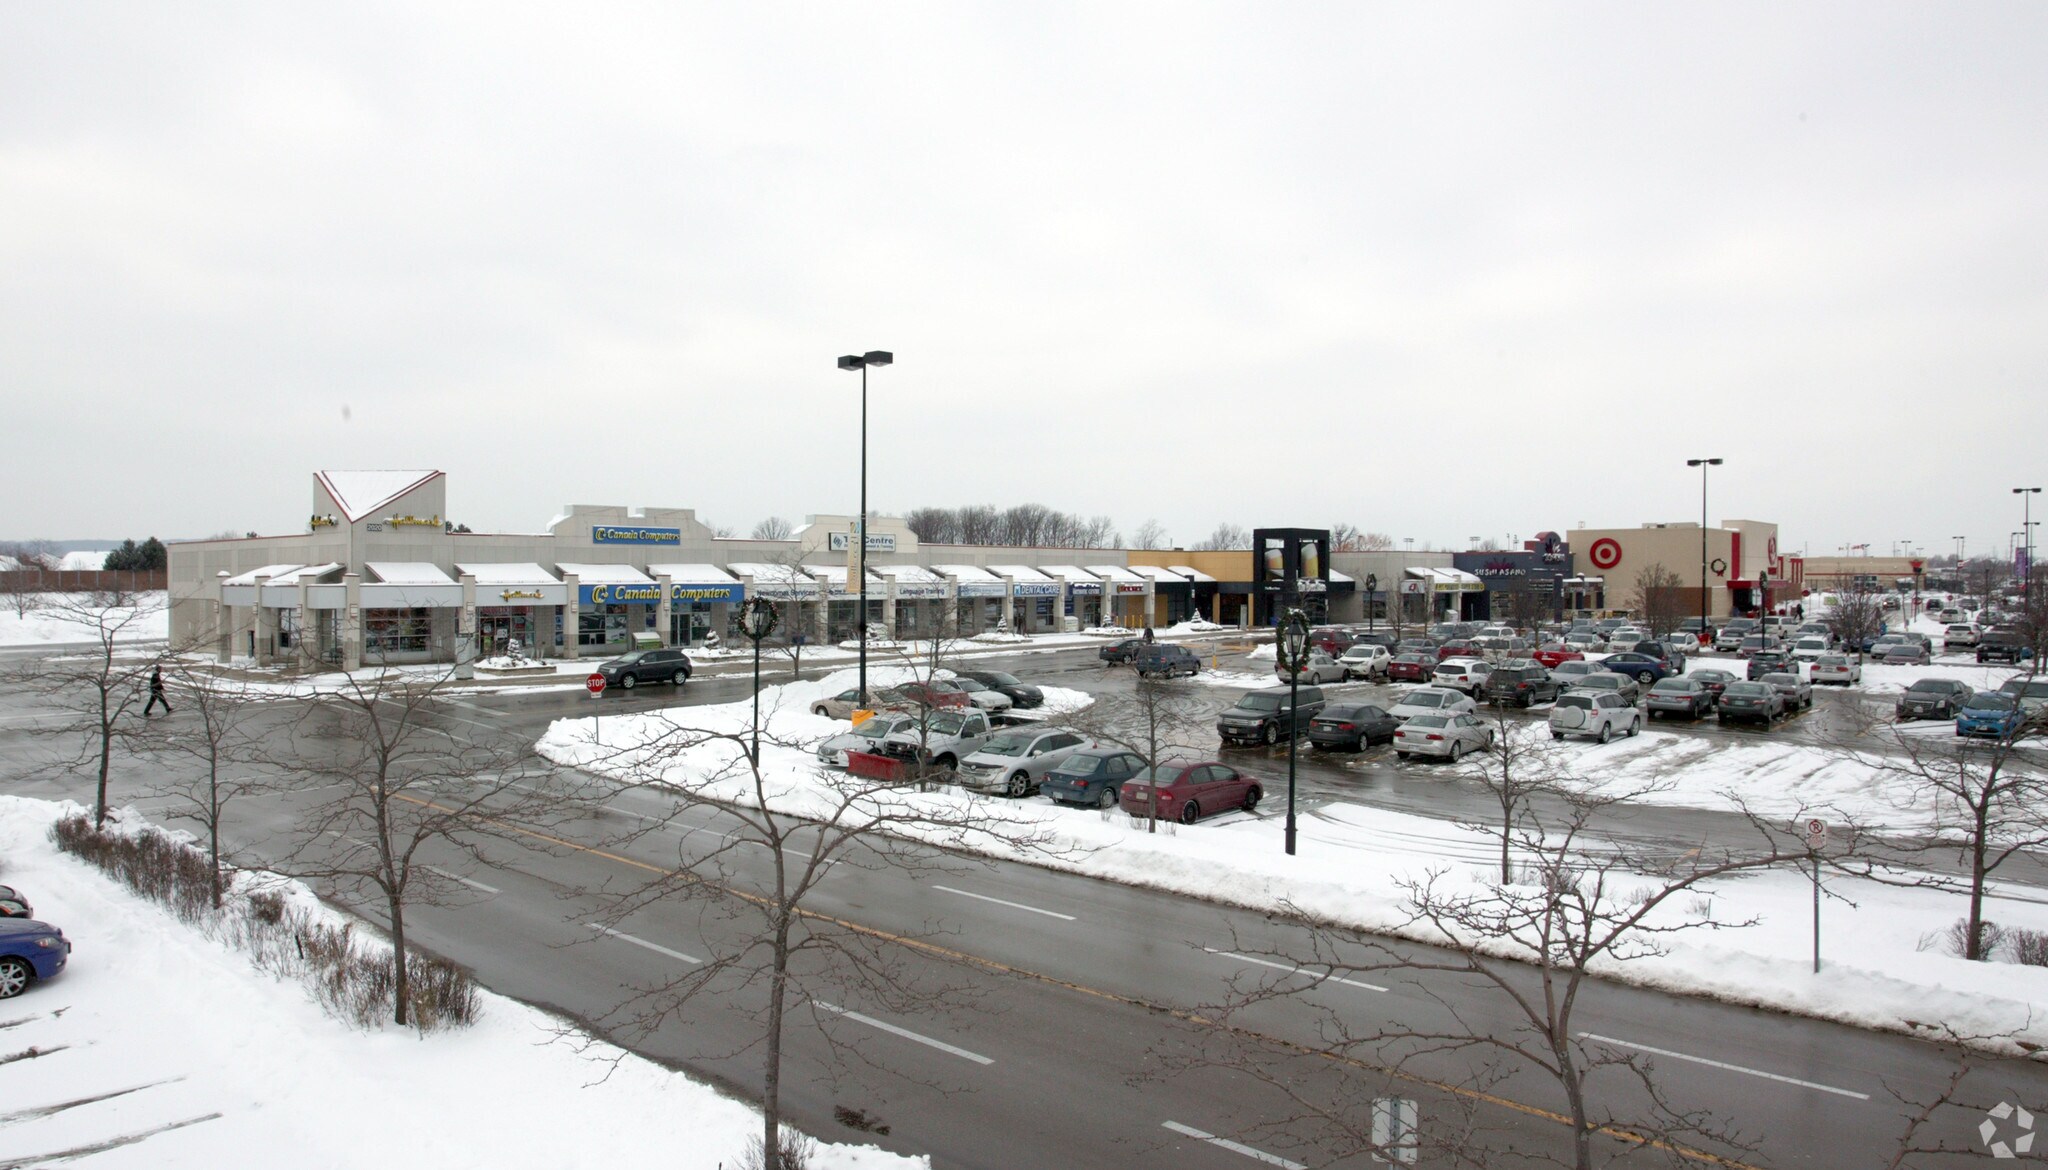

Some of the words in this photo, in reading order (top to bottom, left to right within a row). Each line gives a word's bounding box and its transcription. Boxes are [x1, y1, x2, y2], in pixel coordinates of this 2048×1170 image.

[367, 523, 382, 531] 2020
[607, 529, 638, 540] Canada
[639, 530, 680, 542] Computers
[615, 585, 661, 600] Canada
[671, 585, 730, 602] Computers
[1021, 585, 1044, 594] DENTAL
[1044, 585, 1060, 594] CARE
[587, 678, 605, 688] STOP
